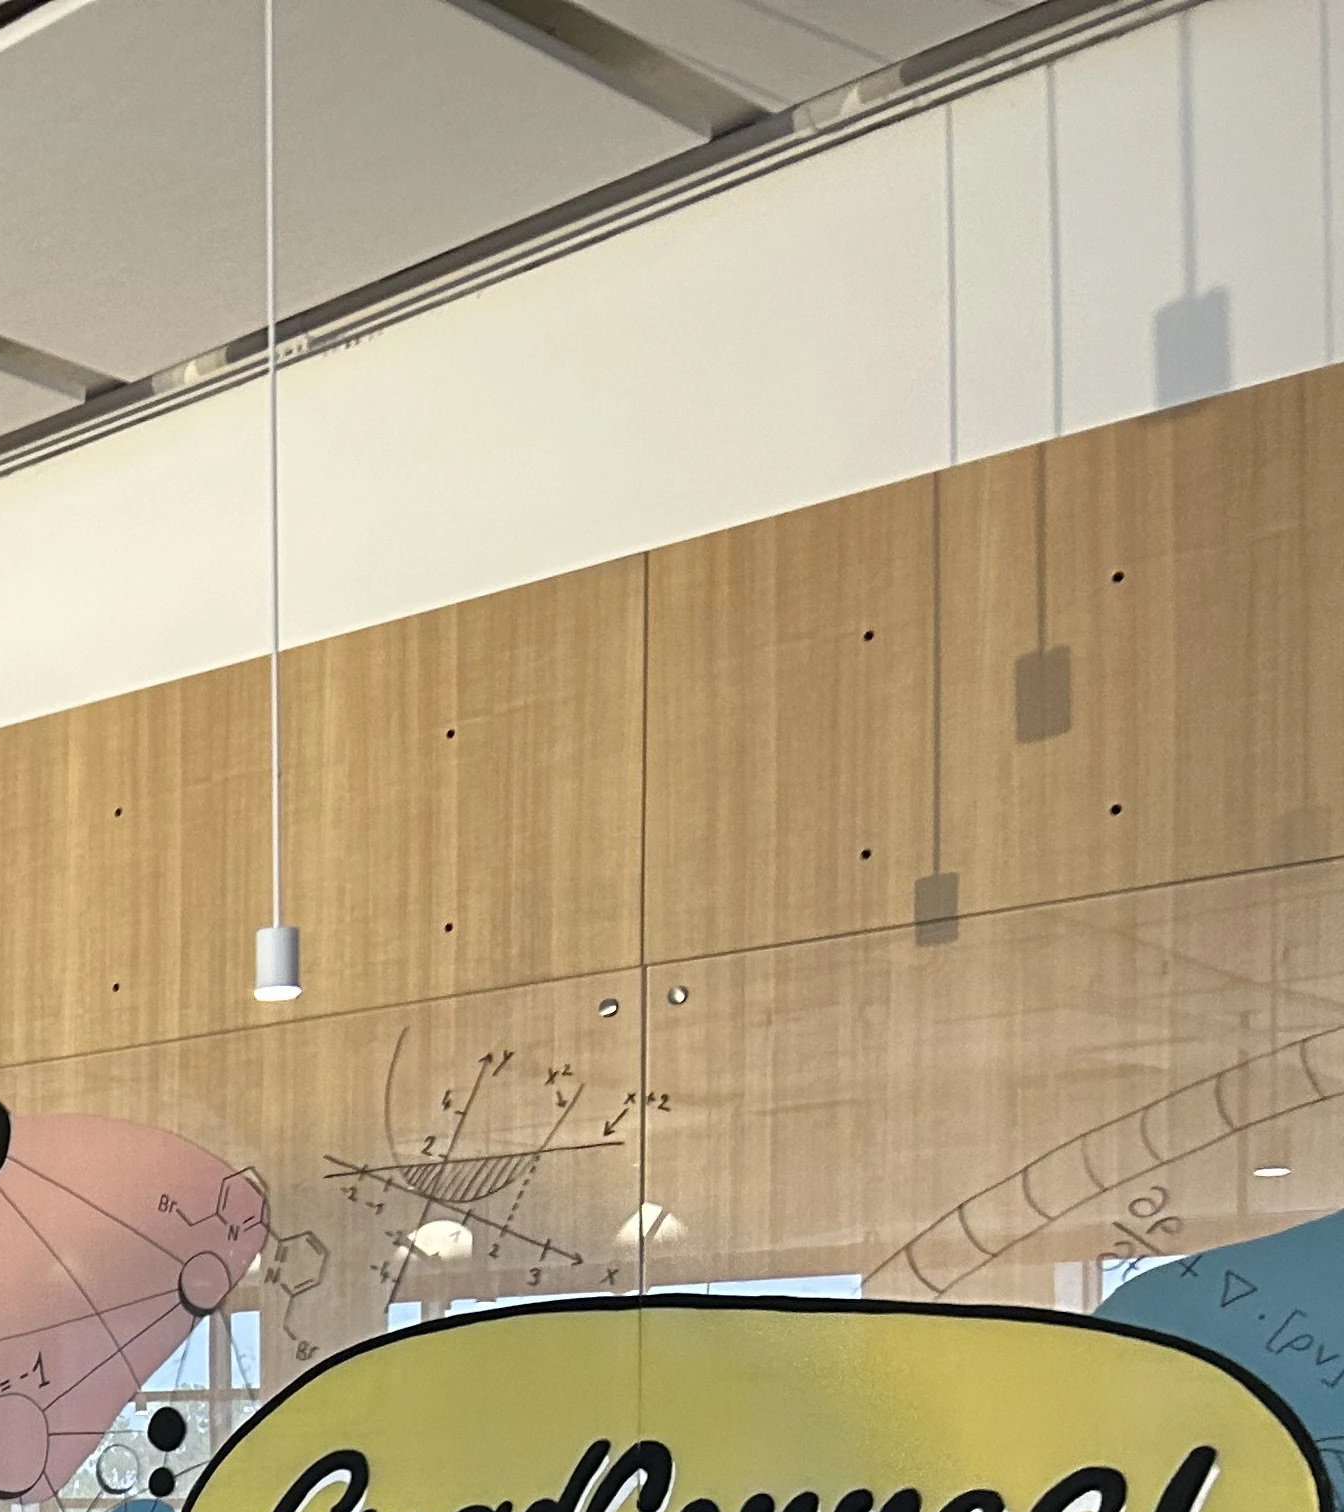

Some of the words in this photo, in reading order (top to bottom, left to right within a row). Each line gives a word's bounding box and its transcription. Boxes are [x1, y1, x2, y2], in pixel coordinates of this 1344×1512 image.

[421, 1135, 437, 1157] 2
[157, 1193, 177, 1213] Br
[227, 1225, 241, 1241] N
[529, 1267, 541, 1286] 3
[295, 1340, 320, 1361] Br
